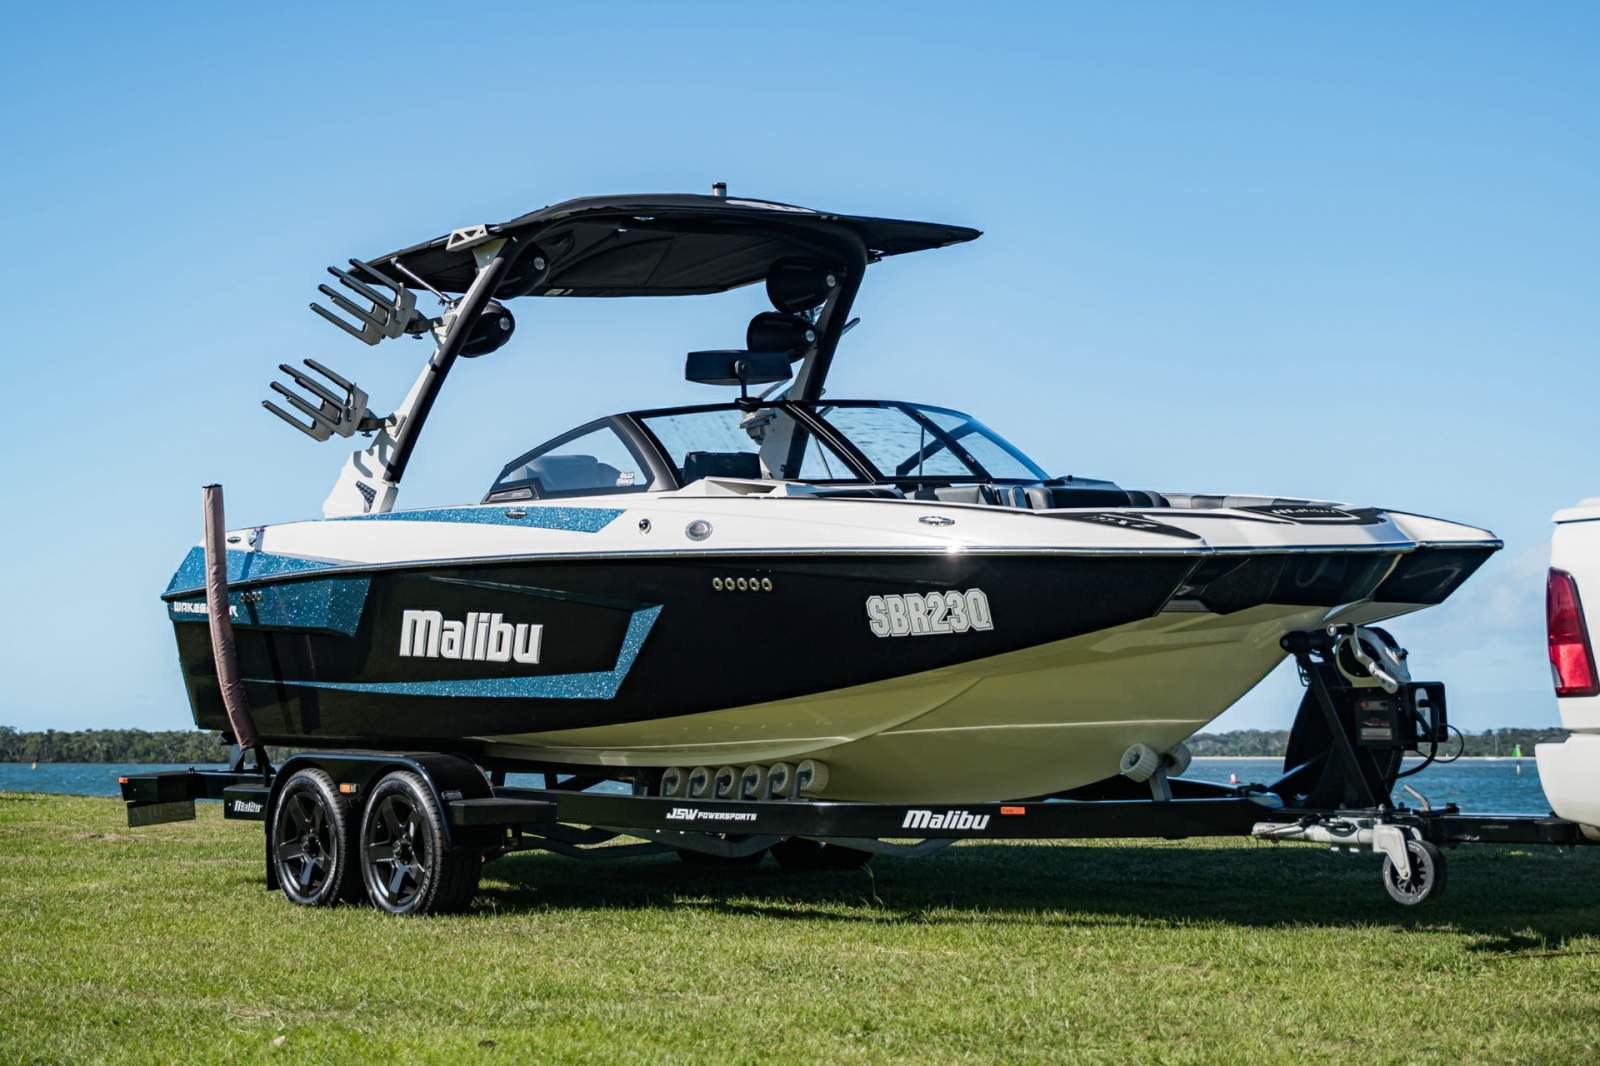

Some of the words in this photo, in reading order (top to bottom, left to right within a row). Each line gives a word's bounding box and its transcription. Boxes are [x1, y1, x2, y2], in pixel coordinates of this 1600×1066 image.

[866, 588, 994, 638] SBR23Q
[399, 609, 544, 664] Malibu
[666, 807, 699, 820] JSW
[902, 809, 990, 830] Malibu
